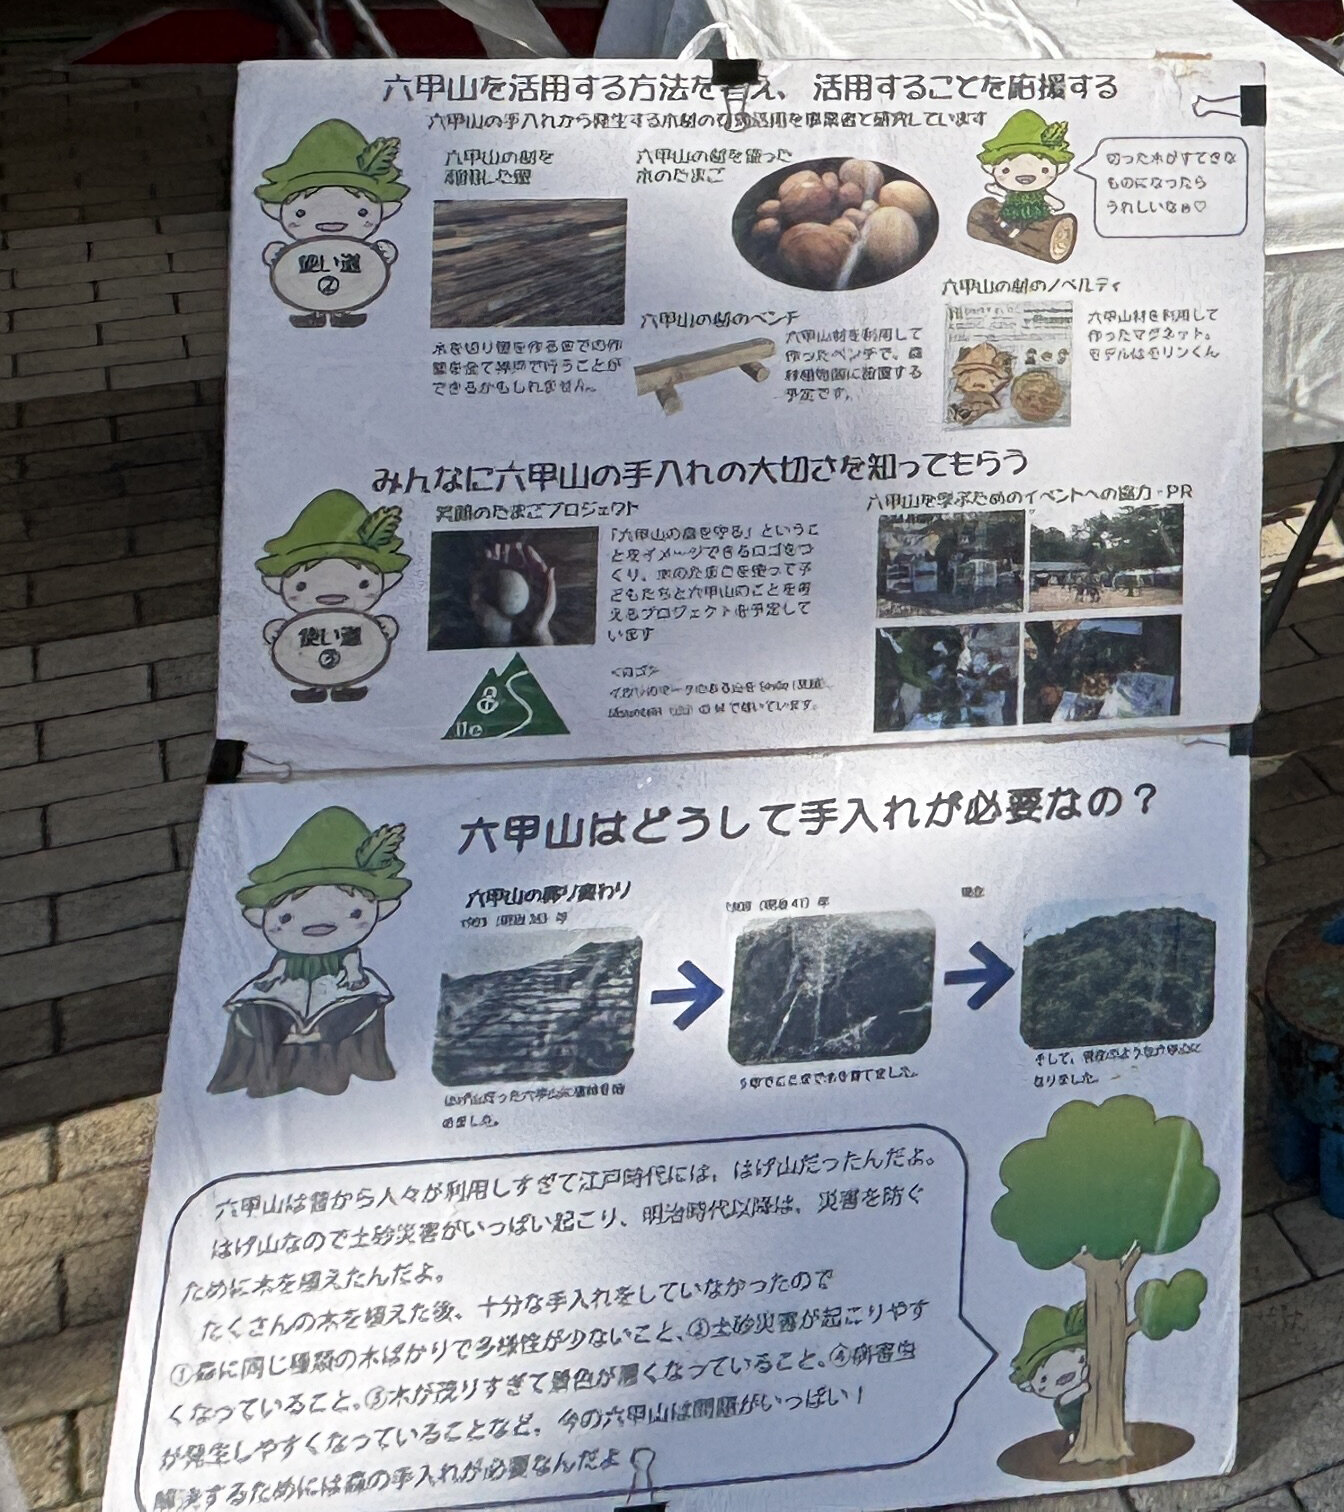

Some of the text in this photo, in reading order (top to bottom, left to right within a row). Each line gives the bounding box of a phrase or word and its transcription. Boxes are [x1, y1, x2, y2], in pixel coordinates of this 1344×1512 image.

[371, 448, 1029, 495] みんなに六甲山の手入れの大切さを知ってもらう
[456, 783, 1159, 855] 六甲山はどうして手入れが必要なの？
